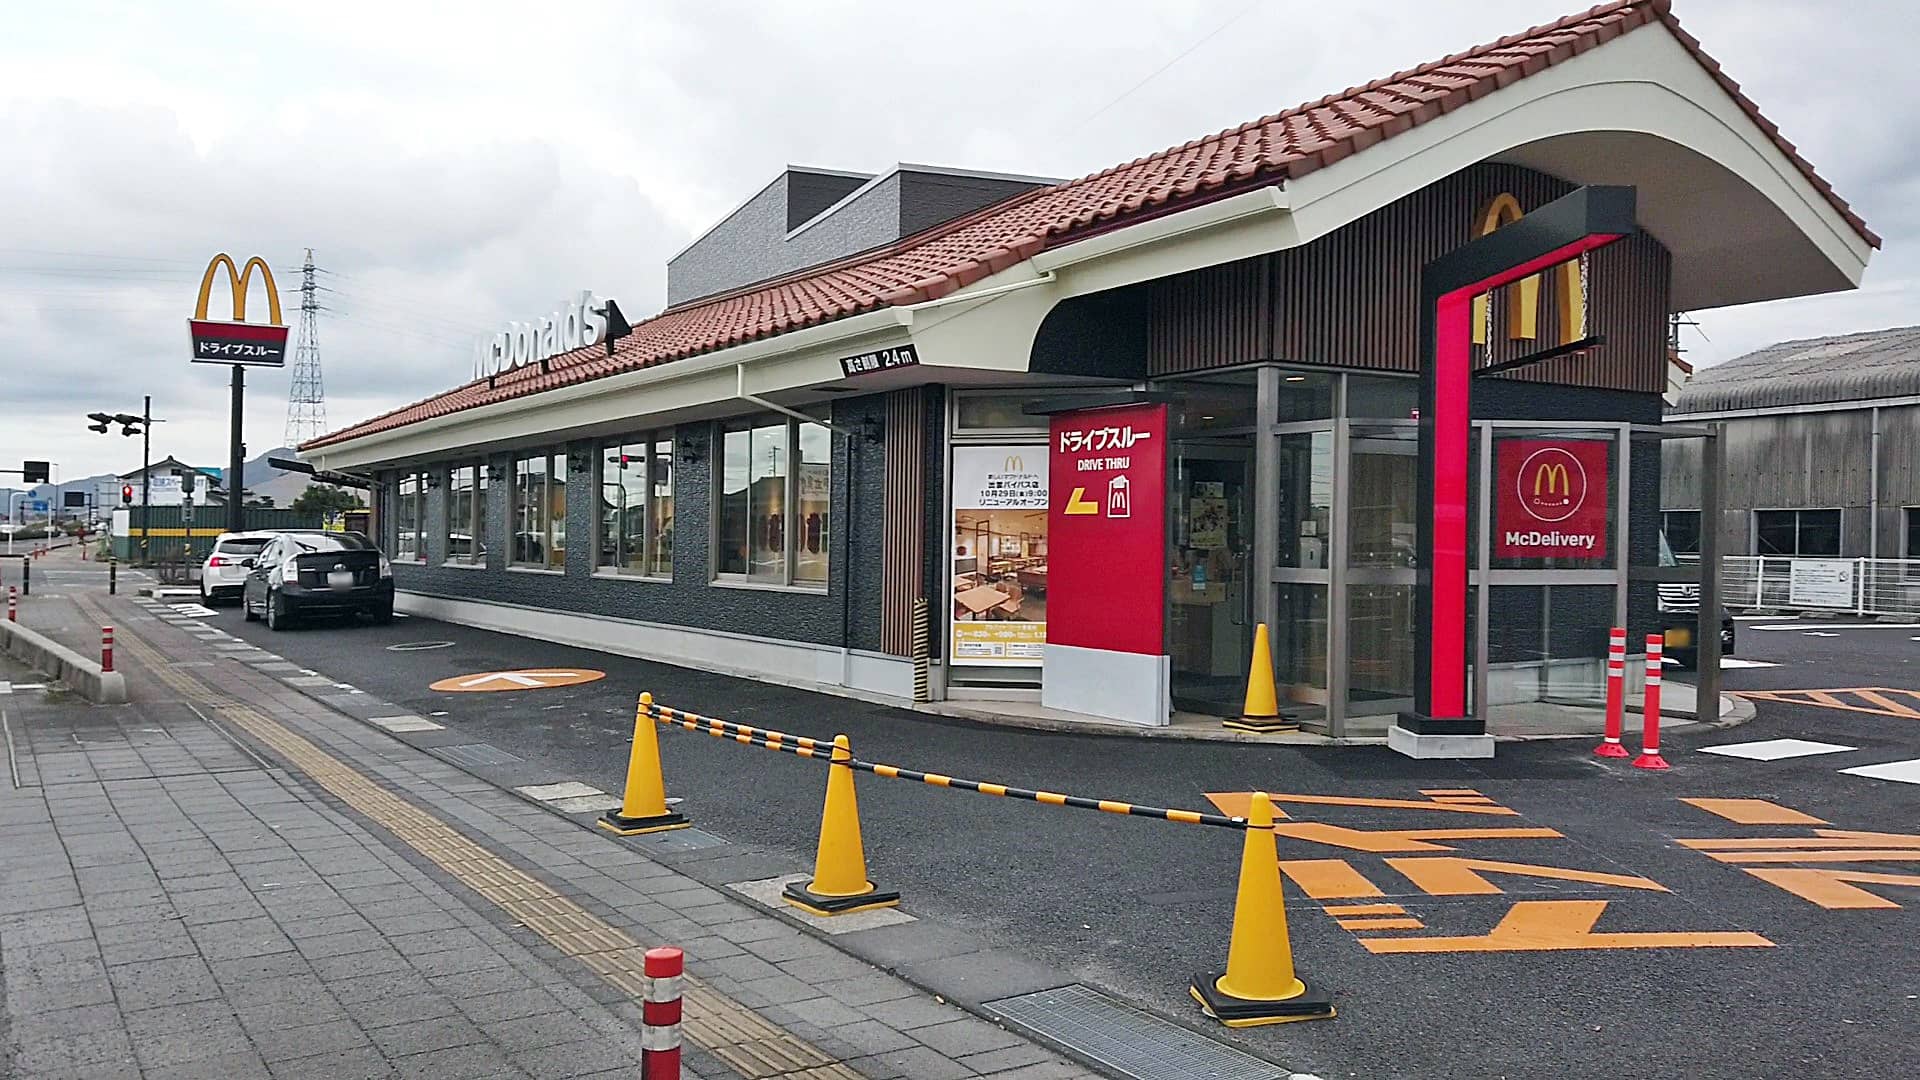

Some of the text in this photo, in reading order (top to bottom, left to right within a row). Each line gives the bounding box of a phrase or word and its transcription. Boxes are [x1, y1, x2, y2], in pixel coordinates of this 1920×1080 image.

[471, 289, 608, 381] McDonald's
[200, 342, 279, 356] ドライブスルー
[1059, 425, 1151, 453] ドライブスルー
[1077, 456, 1130, 471] DRIVE THRU
[1505, 531, 1595, 549] McDelivery
